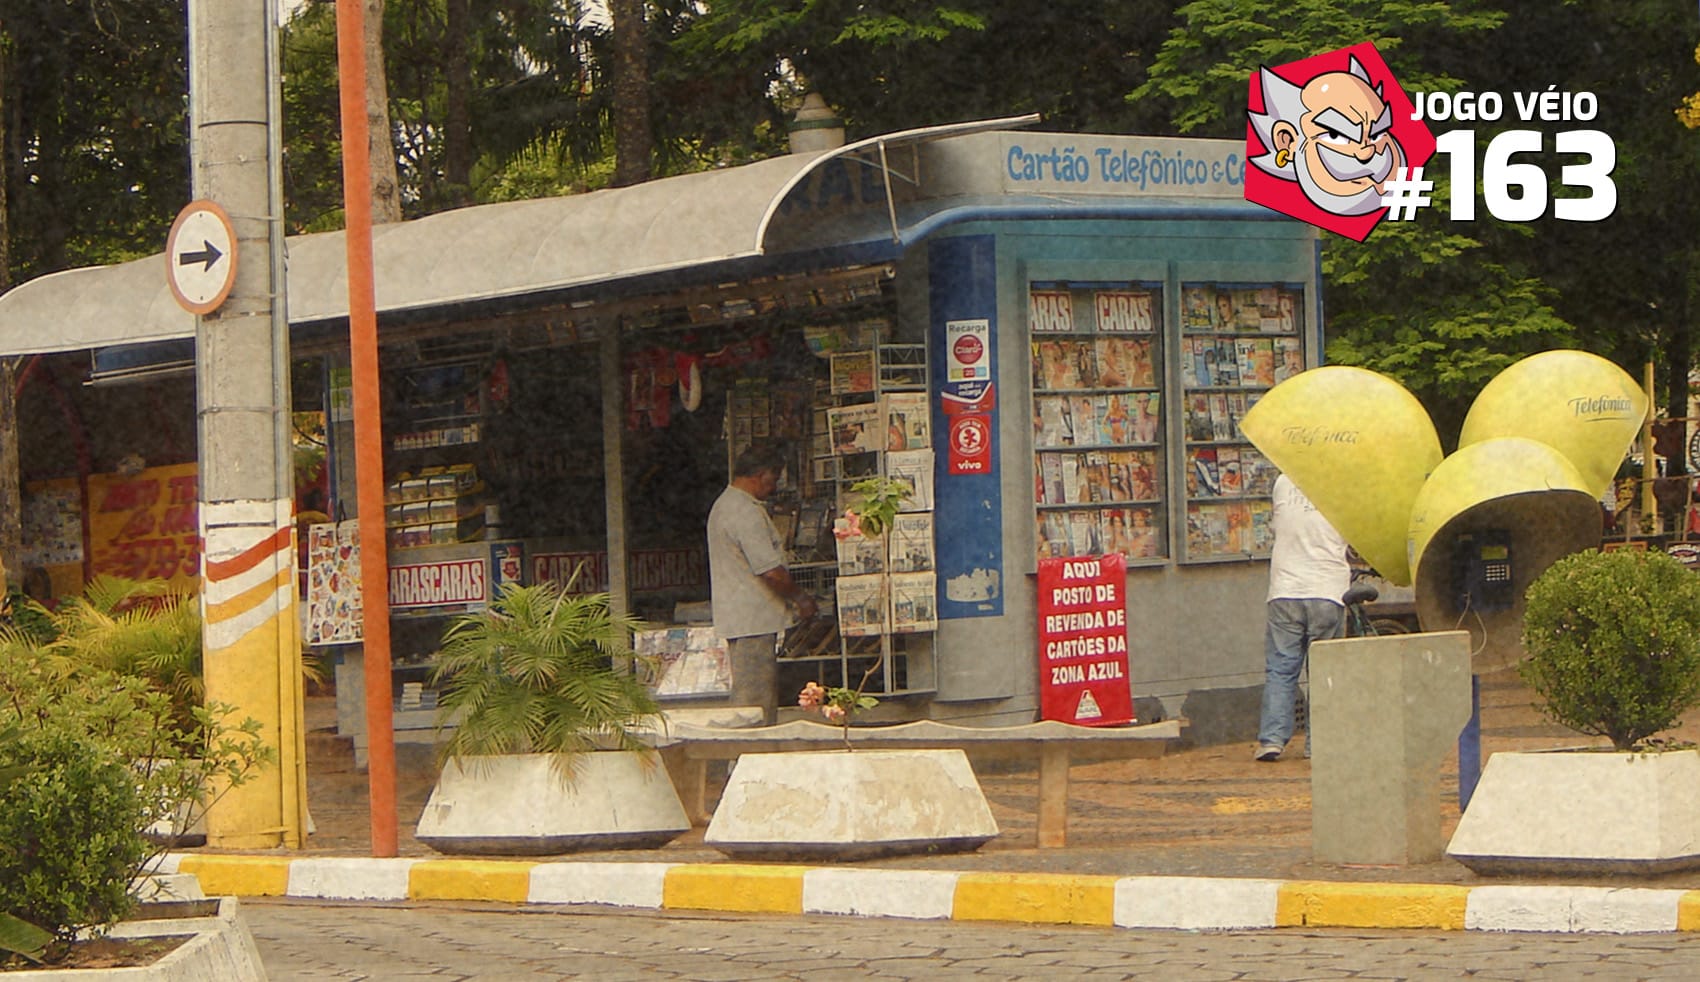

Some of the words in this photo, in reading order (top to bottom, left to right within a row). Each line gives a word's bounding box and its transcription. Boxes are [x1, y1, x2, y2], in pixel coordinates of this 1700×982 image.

[1008, 145, 1090, 183] Cartão
[1095, 147, 1208, 190] Telefônico
[1211, 160, 1225, 183] &
[1098, 295, 1153, 331] CARAS
[949, 324, 986, 333] Recarga
[957, 459, 982, 470] vivo
[1063, 561, 1100, 579] AQUI
[1053, 586, 1092, 606] POSTO
[1096, 584, 1115, 602] DE
[1046, 612, 1104, 633] REVENDA
[1107, 609, 1124, 627] DE
[1047, 635, 1105, 659] CARTÕES
[1107, 635, 1126, 653] DA
[1052, 665, 1085, 685] ZONA
[1088, 661, 1123, 681] AZUL
